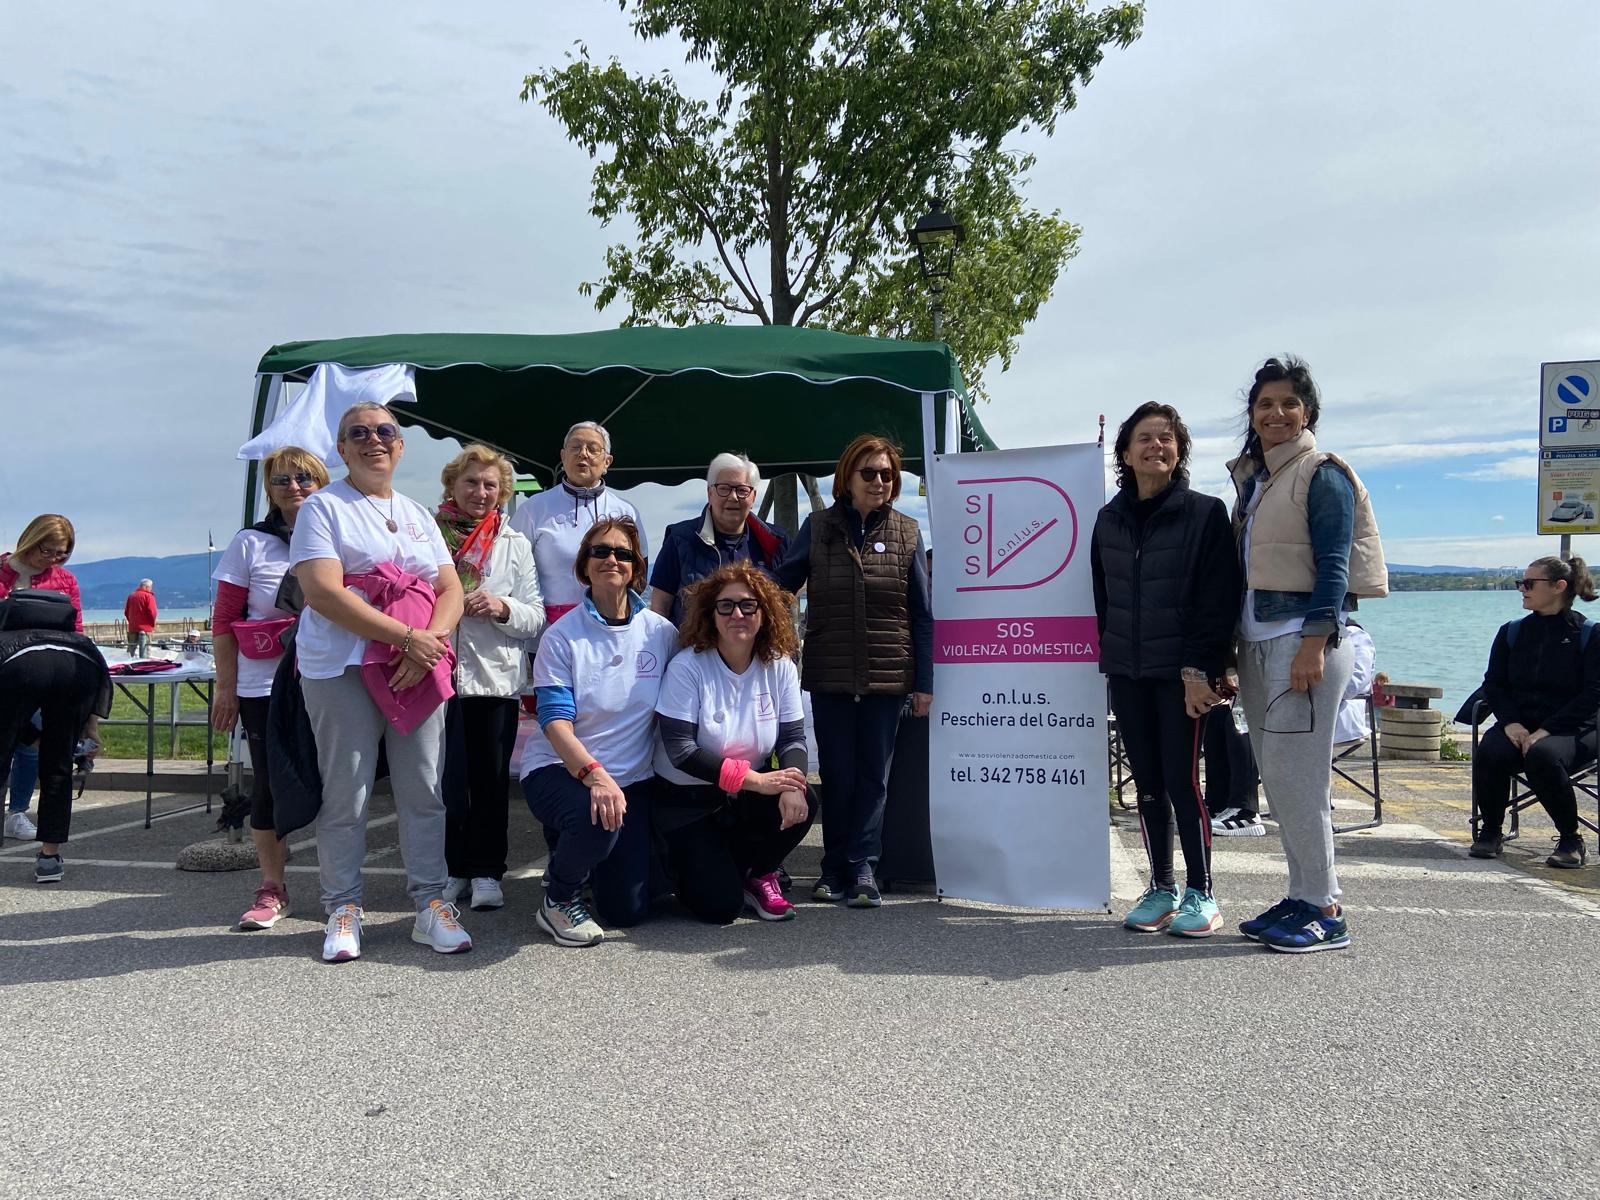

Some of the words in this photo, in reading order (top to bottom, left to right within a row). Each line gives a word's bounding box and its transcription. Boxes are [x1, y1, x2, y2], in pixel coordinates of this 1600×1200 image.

[1552, 418, 1564, 431] P
[997, 519, 1044, 557] o.n.l.u.s.
[997, 622, 1035, 639] SOS
[942, 644, 1008, 657] VIOLENZA
[1013, 642, 1094, 656] DOMESTICA
[982, 689, 1051, 705] o.n.l.u.s.
[941, 712, 1016, 727] Peschiera
[1019, 712, 1043, 727] del
[1047, 712, 1095, 728] Garda
[958, 751, 1076, 761] www.sosviolenzadomestica.com
[950, 767, 976, 783] tel.
[980, 766, 1011, 784] 342
[1015, 767, 1046, 785] 758
[1051, 768, 1086, 786] 4161
